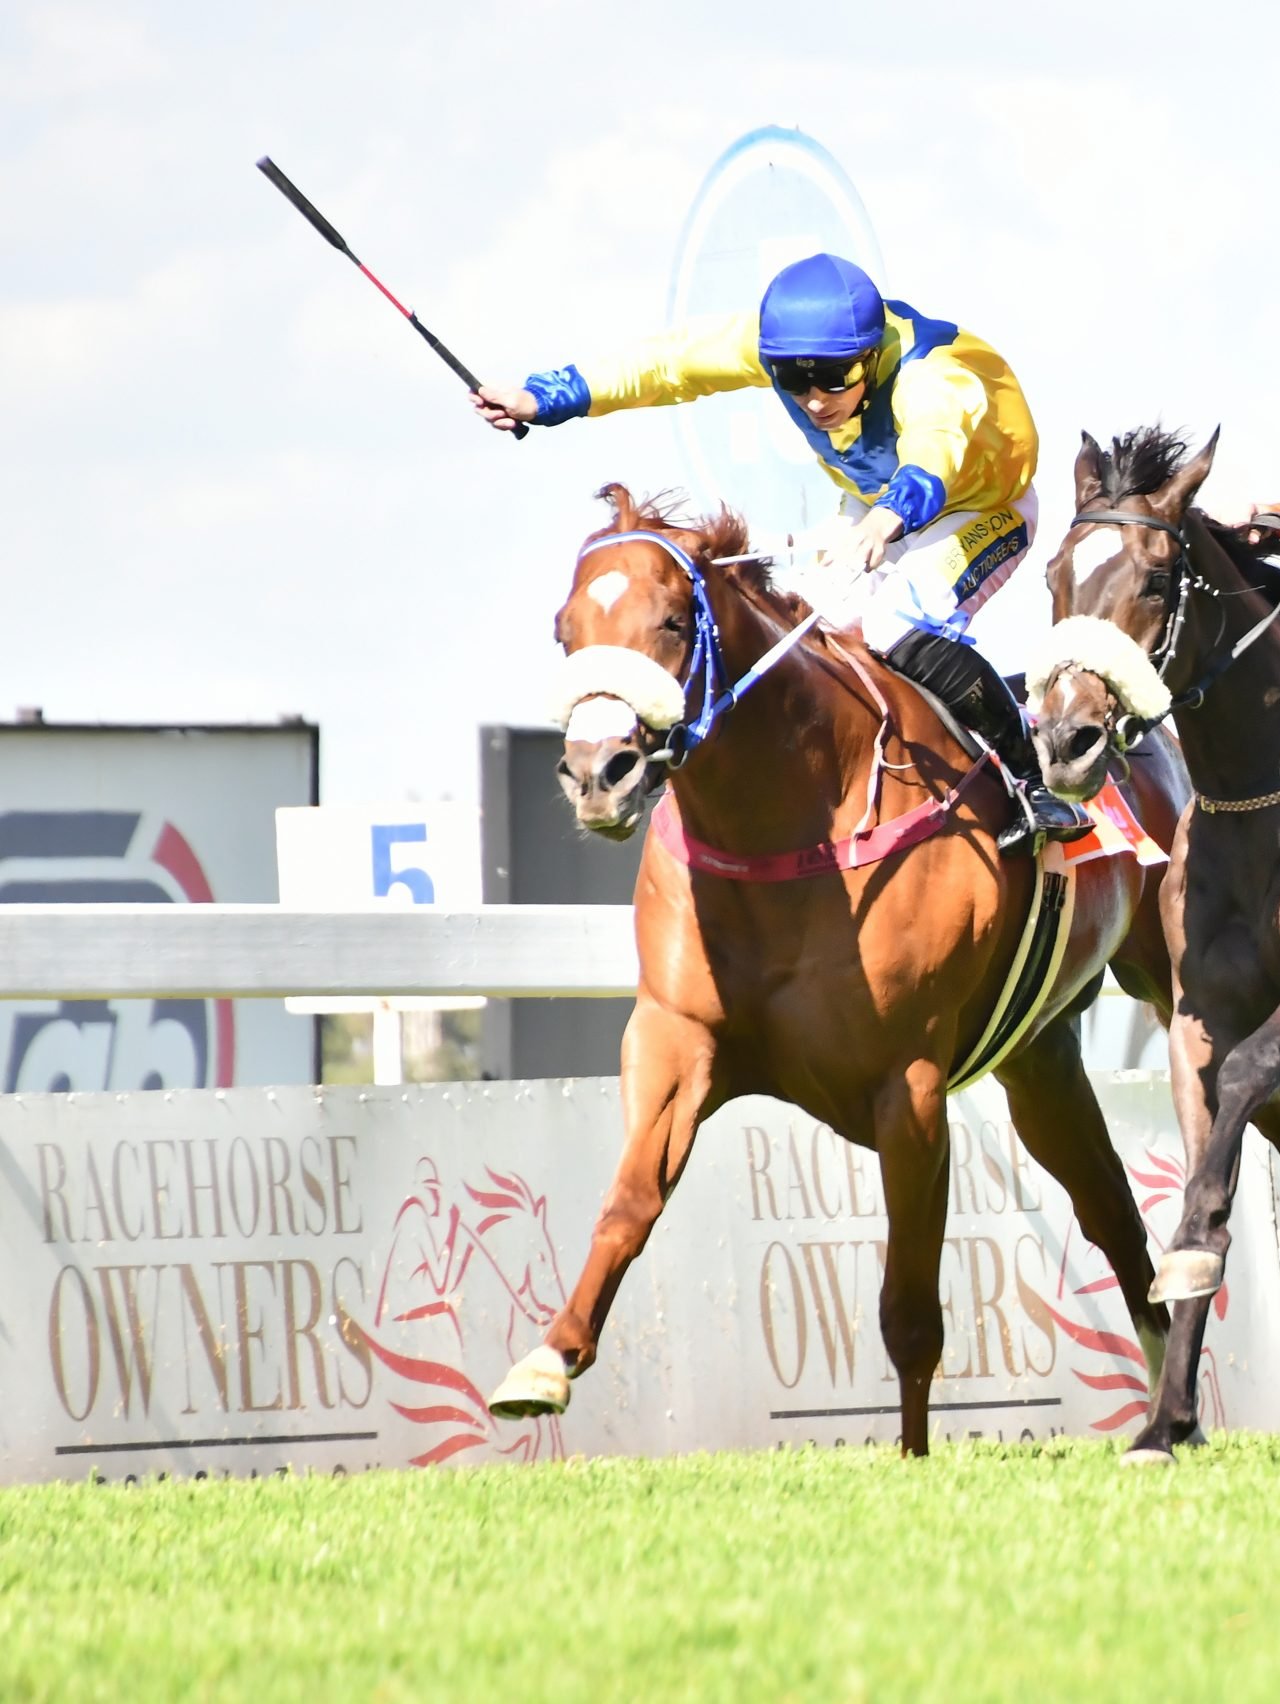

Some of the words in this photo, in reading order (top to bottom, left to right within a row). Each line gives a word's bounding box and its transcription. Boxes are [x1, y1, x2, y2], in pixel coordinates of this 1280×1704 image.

[371, 823, 435, 904] 5
[35, 1135, 364, 1243] RACEHORSE
[742, 1120, 1043, 1221] RACERSE
[48, 1257, 374, 1422] OWNERS
